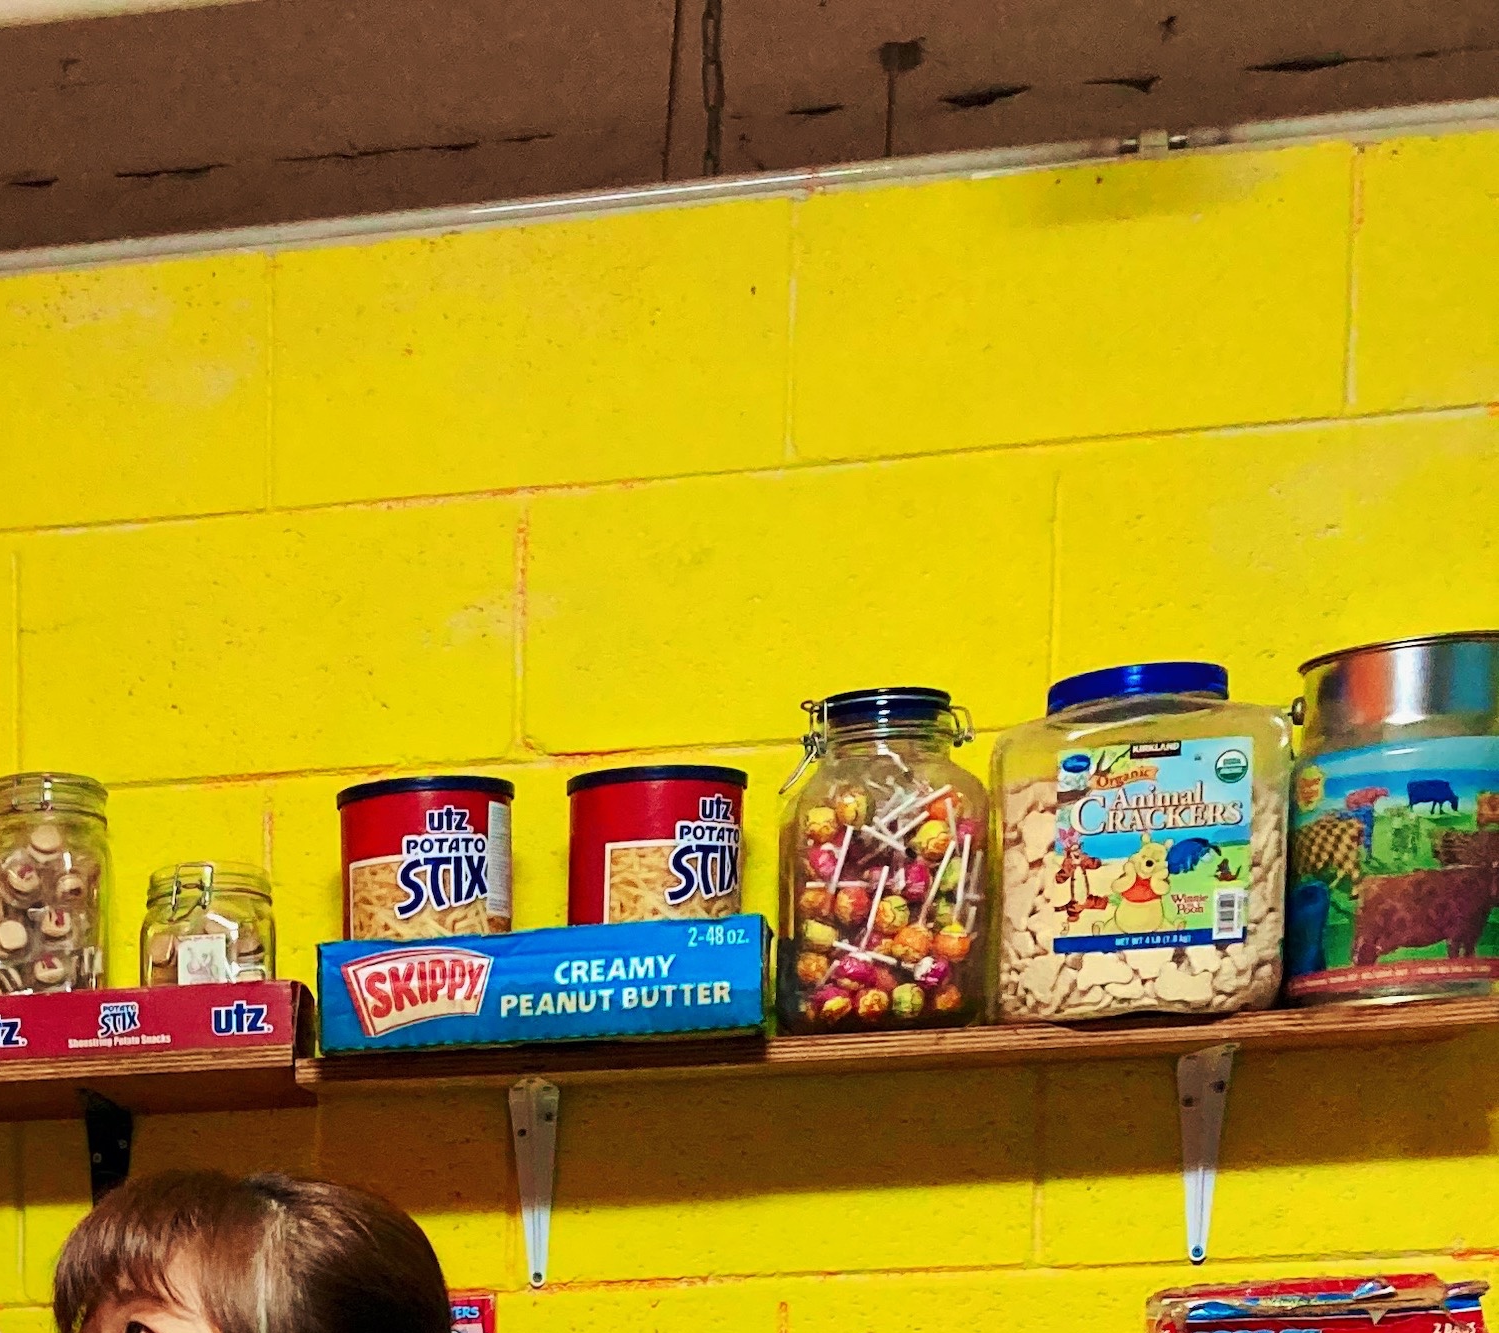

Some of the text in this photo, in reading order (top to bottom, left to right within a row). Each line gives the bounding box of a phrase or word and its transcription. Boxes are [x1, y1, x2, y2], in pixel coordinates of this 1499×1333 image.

[1132, 742, 1180, 753] KIRKLAND
[1095, 766, 1150, 790] Organic
[1111, 780, 1204, 811] Animal
[1070, 795, 1243, 835] CRACKERS
[405, 837, 486, 855] POTATO
[679, 825, 740, 844] POTATO
[397, 855, 488, 916] STIX
[668, 843, 739, 901] STIX
[687, 924, 725, 948] 2-48
[553, 953, 677, 985] CREAMY
[364, 957, 485, 1019] SKIPPY
[500, 980, 731, 1018] PEANUT BUTTER
[100, 1010, 138, 1036] STIX
